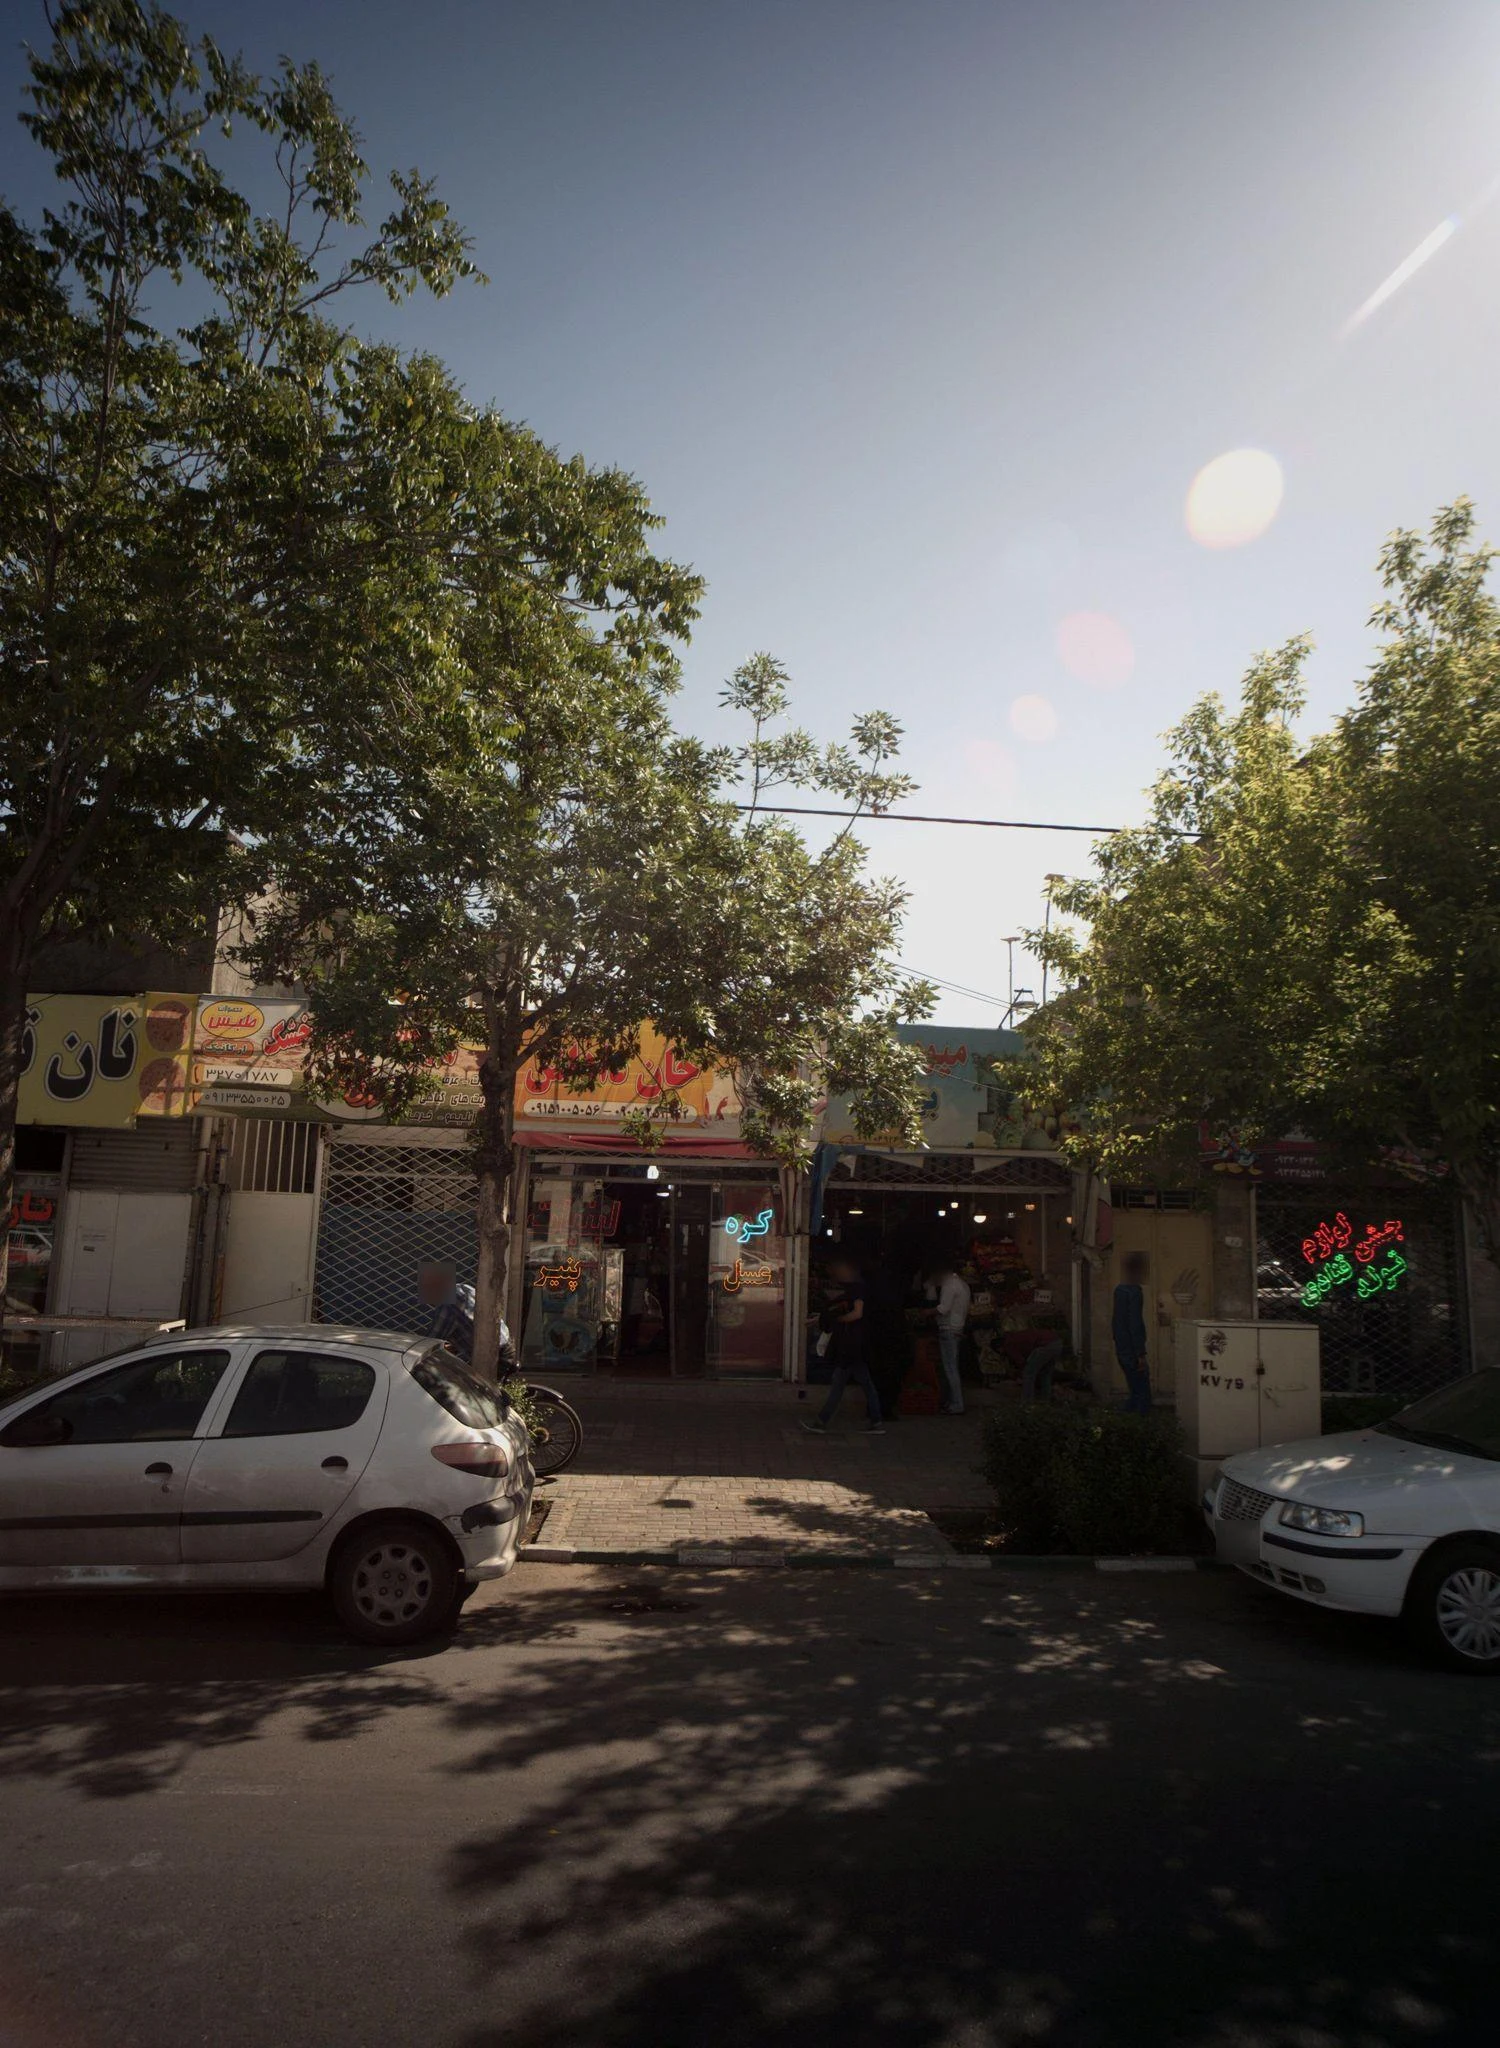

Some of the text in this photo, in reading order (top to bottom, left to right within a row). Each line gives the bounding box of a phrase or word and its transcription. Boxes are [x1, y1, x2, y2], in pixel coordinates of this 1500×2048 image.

[207, 1014, 258, 1033] طبس
[45, 1007, 137, 1101] نان
[206, 1068, 279, 1082] ۳۲۷۰۱۷۸۷
[636, 1047, 700, 1100] خان
[724, 1207, 774, 1244] کره
[533, 1256, 582, 1293] پنیر
[723, 1257, 773, 1293] عسل
[1356, 1248, 1409, 1299] تولد
[1200, 1359, 1218, 1371] TL
[1200, 1374, 1221, 1388] KV
